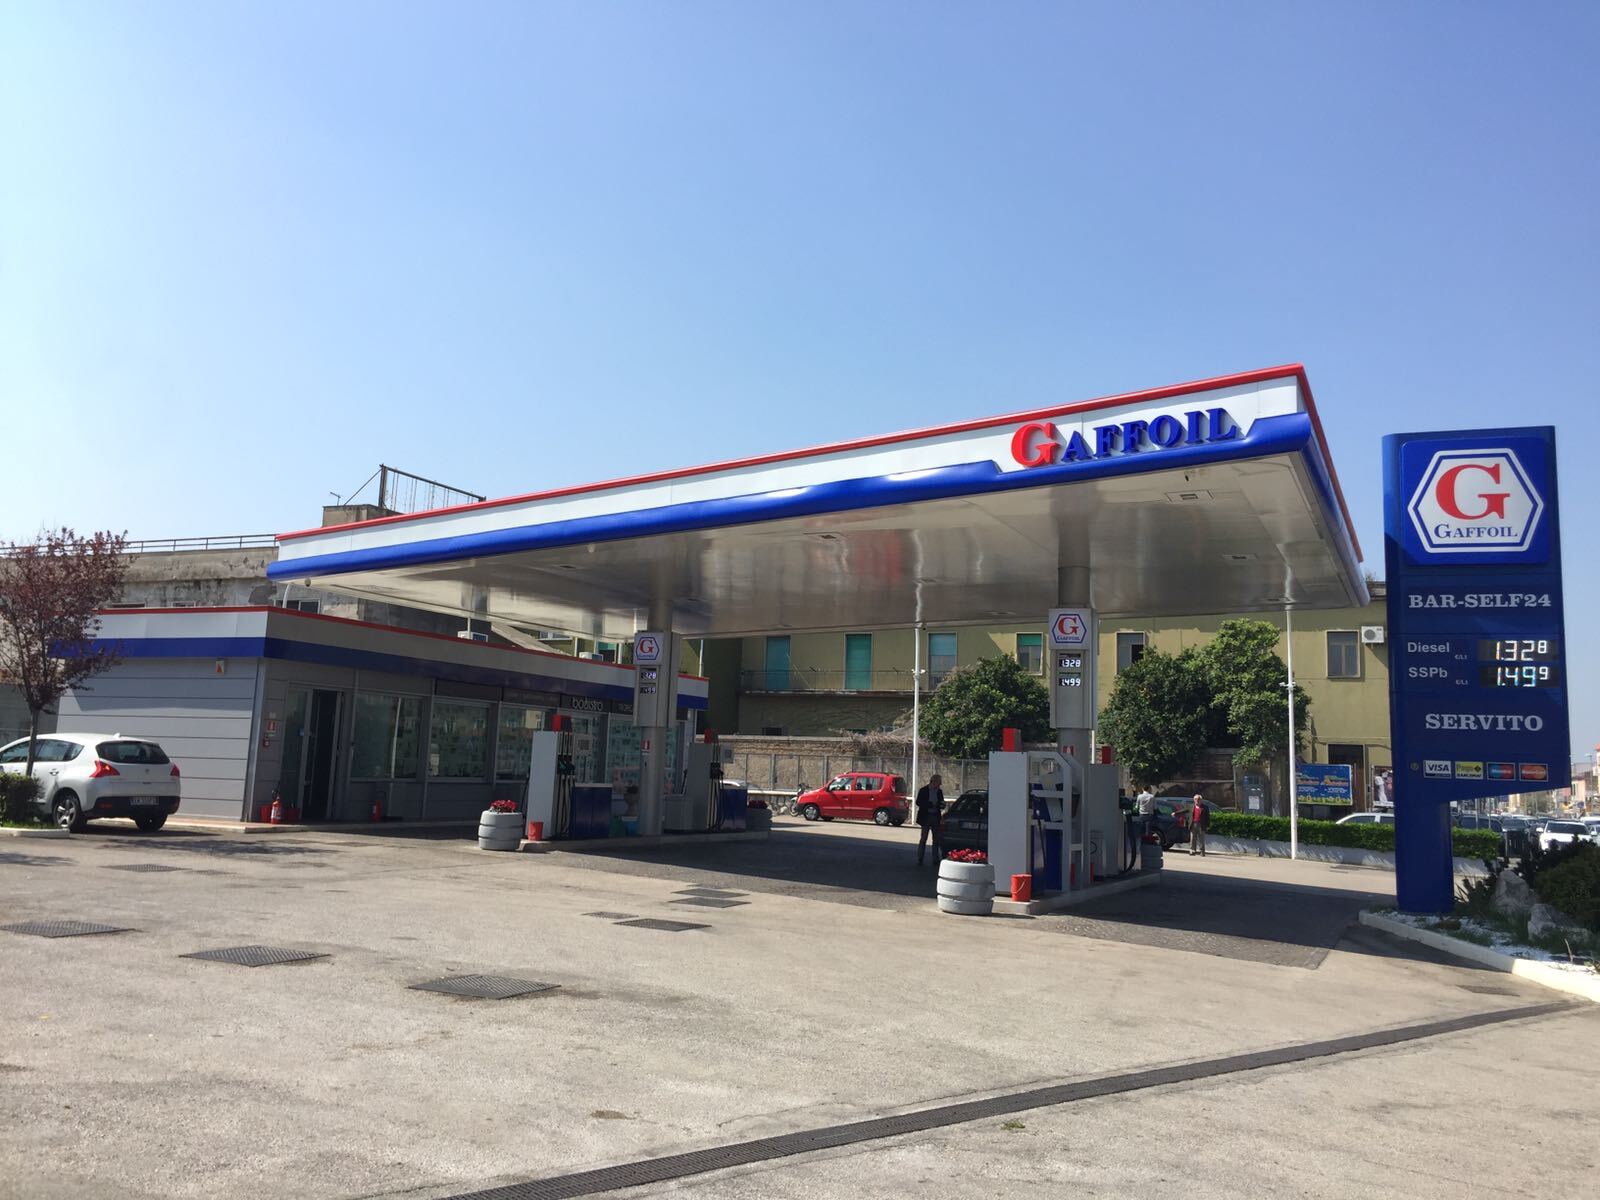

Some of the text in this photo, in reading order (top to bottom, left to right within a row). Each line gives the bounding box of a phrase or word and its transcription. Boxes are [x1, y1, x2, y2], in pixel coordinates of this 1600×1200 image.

[1011, 408, 1237, 468] GAFFOIL
[1435, 463, 1510, 520] G
[1434, 523, 1518, 540] GAFFOIL
[1408, 593, 1551, 609] BAR-SELF24
[1407, 641, 1450, 653] Diesel
[1408, 666, 1448, 678] SSPb
[1425, 713, 1543, 732] SERVITO
[1427, 764, 1450, 772] VISA
